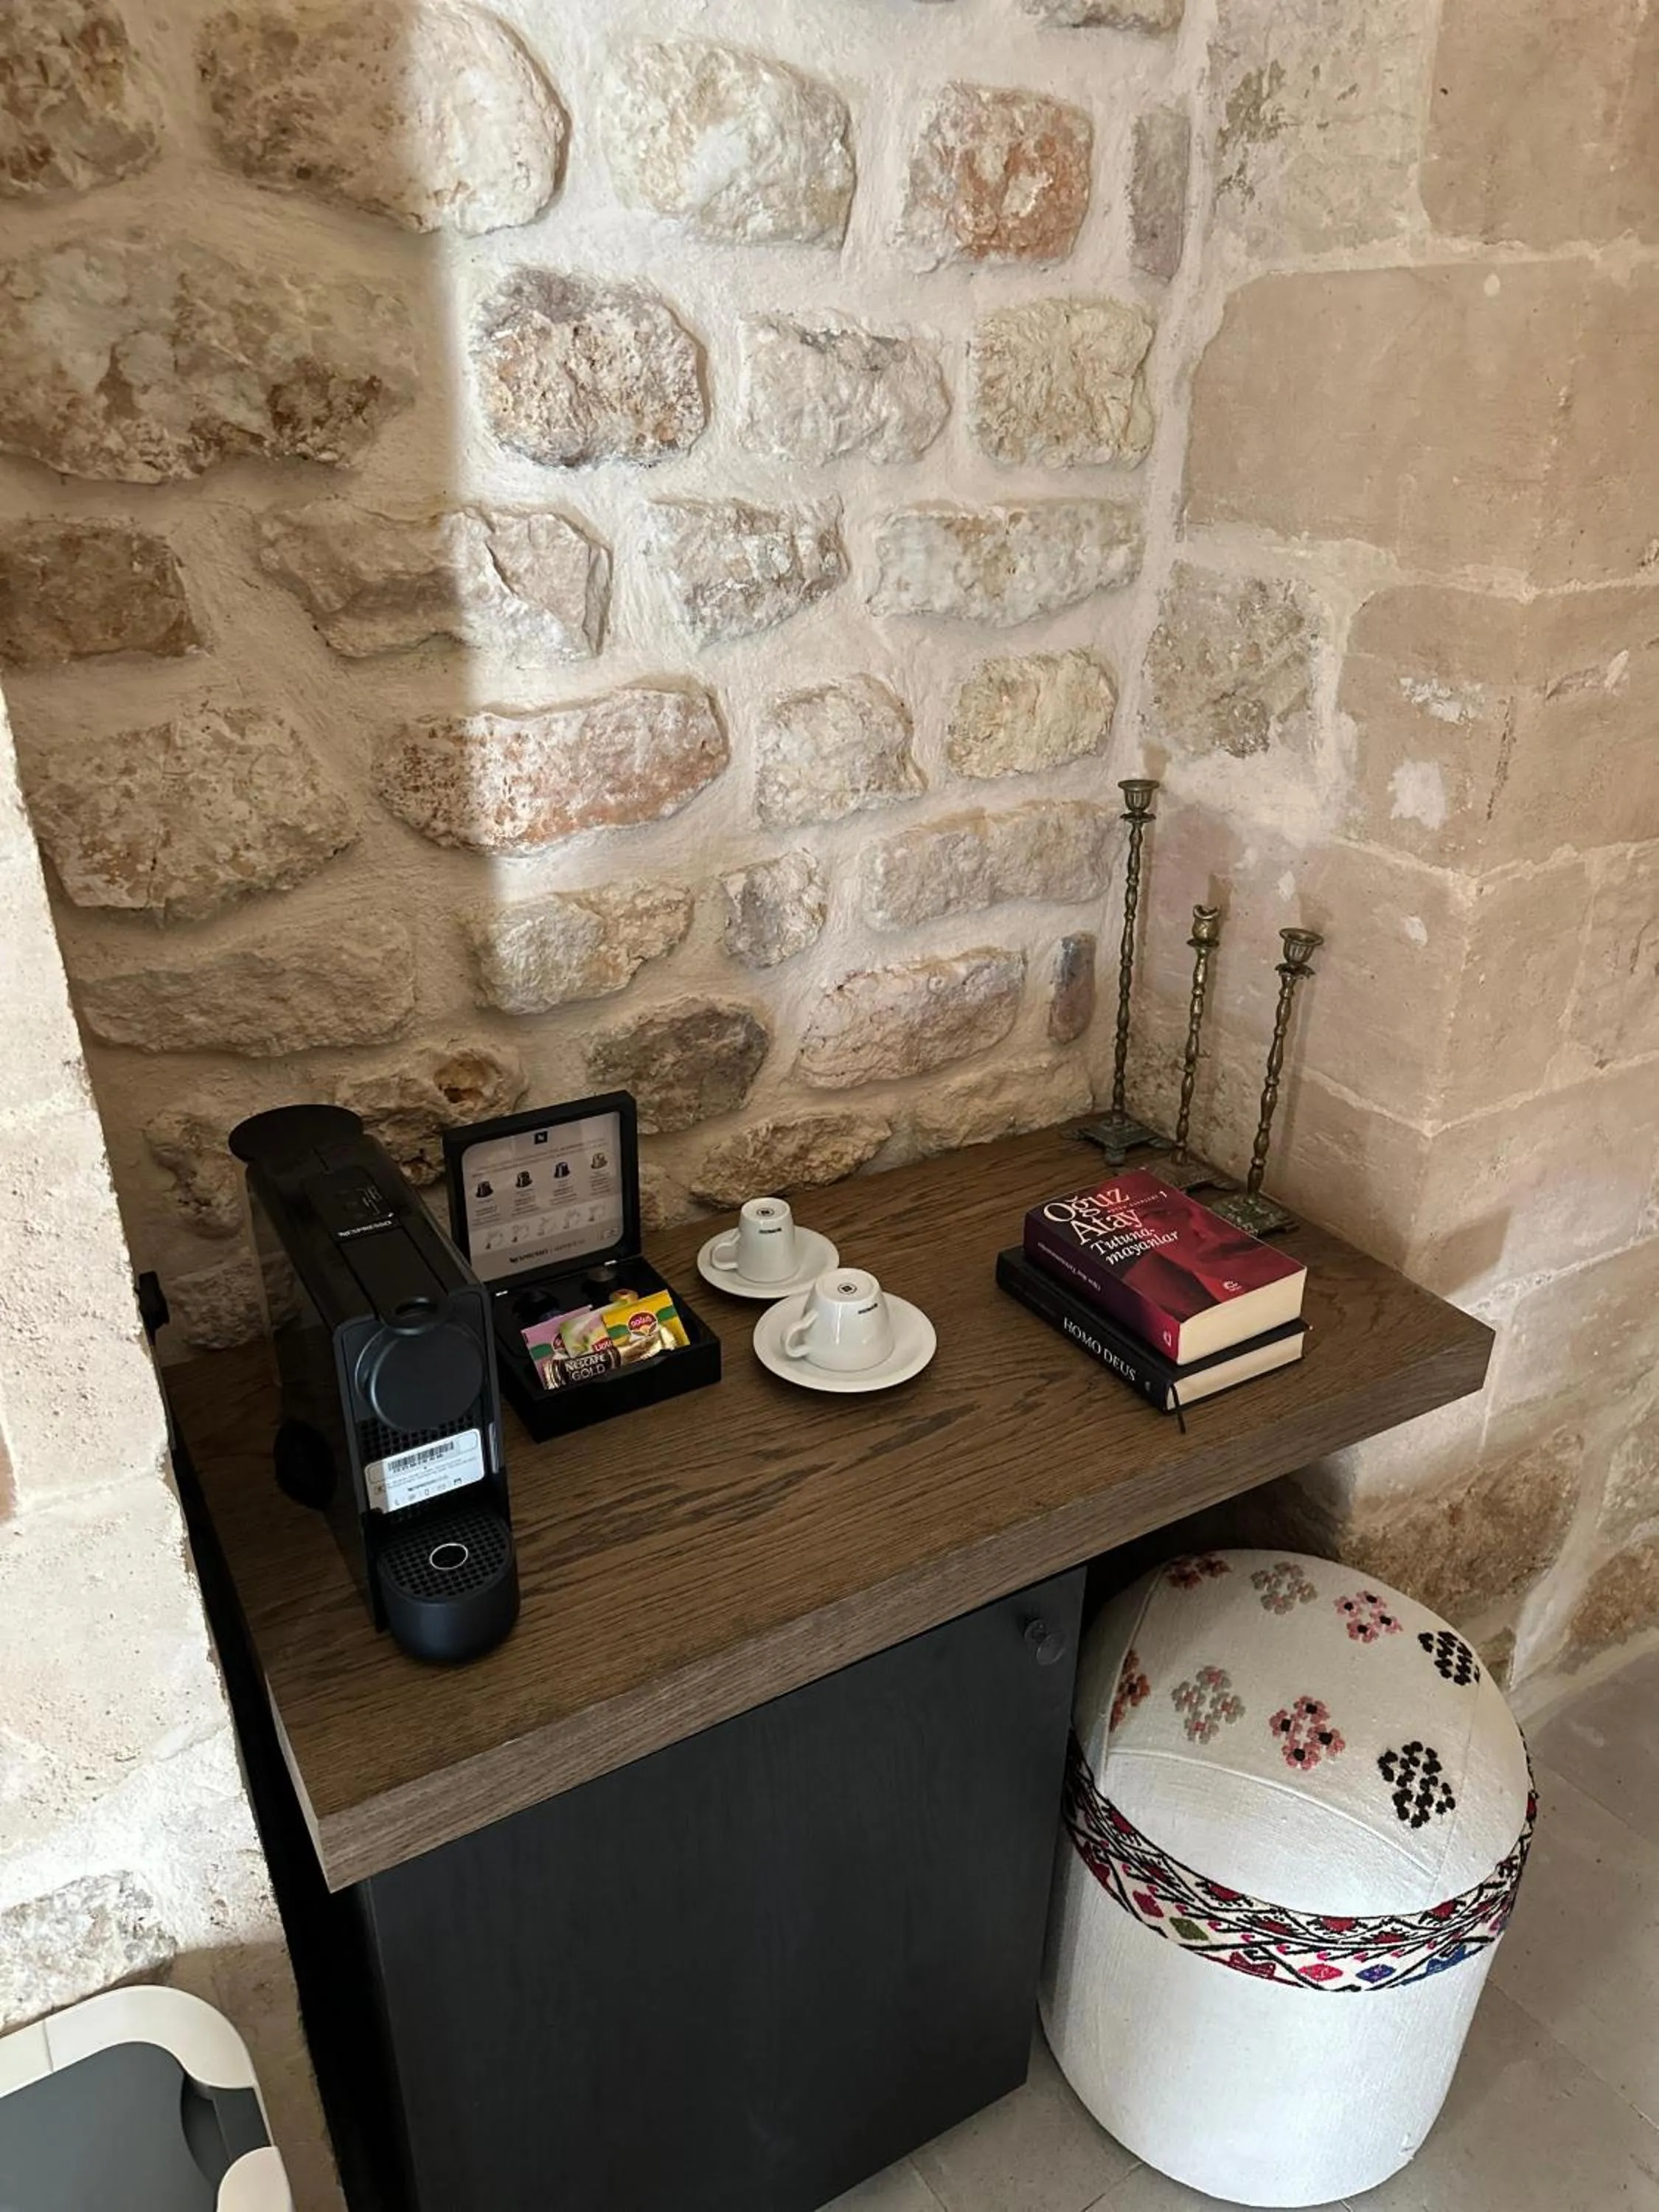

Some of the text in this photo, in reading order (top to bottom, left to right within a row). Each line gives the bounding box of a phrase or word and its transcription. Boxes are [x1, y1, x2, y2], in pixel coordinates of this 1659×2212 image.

[1043, 1188, 1130, 1222] Oğuz
[1071, 1208, 1142, 1245] Atay
[1091, 1228, 1155, 1255] Tutuna-
[1106, 1231, 1179, 1265] mayanlar
[1064, 1316, 1135, 1381] HOMO DEUS
[572, 1363, 605, 1381] GOLD
